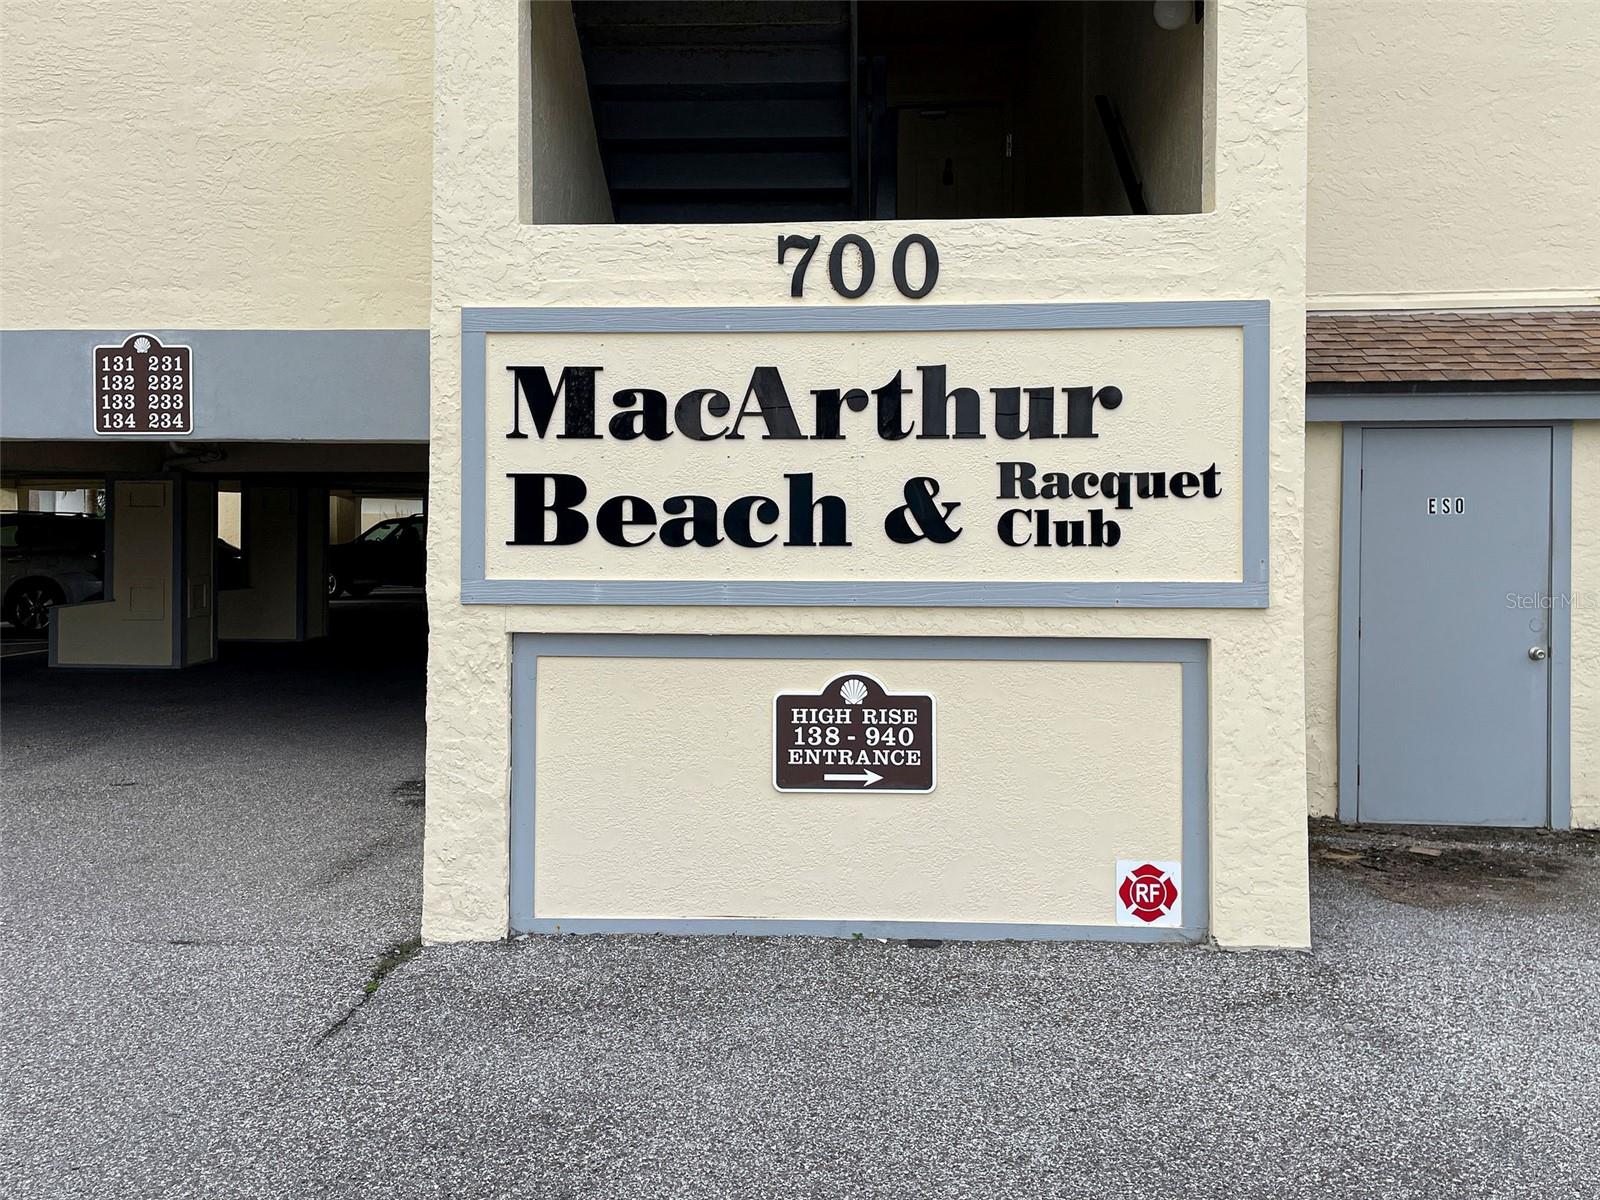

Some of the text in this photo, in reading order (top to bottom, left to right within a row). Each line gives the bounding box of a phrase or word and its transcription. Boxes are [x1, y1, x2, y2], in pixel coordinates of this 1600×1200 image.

[777, 233, 940, 300] 700
[102, 356, 136, 372] 131
[148, 356, 184, 372] 231
[102, 375, 136, 391] 132
[148, 375, 184, 391] 232
[102, 394, 136, 410] 133
[148, 394, 184, 410] 233
[506, 364, 1123, 442] MacArthur
[102, 413, 136, 429] 134
[148, 413, 184, 429] 234
[996, 462, 1223, 510] Racquet
[506, 472, 964, 548] Beach &
[997, 509, 1121, 548] Club
[791, 708, 918, 725] HIGH RISE
[794, 726, 840, 746] 138
[865, 727, 914, 747] 940
[787, 749, 921, 766] ENTRANCE
[1135, 883, 1161, 903] RF
